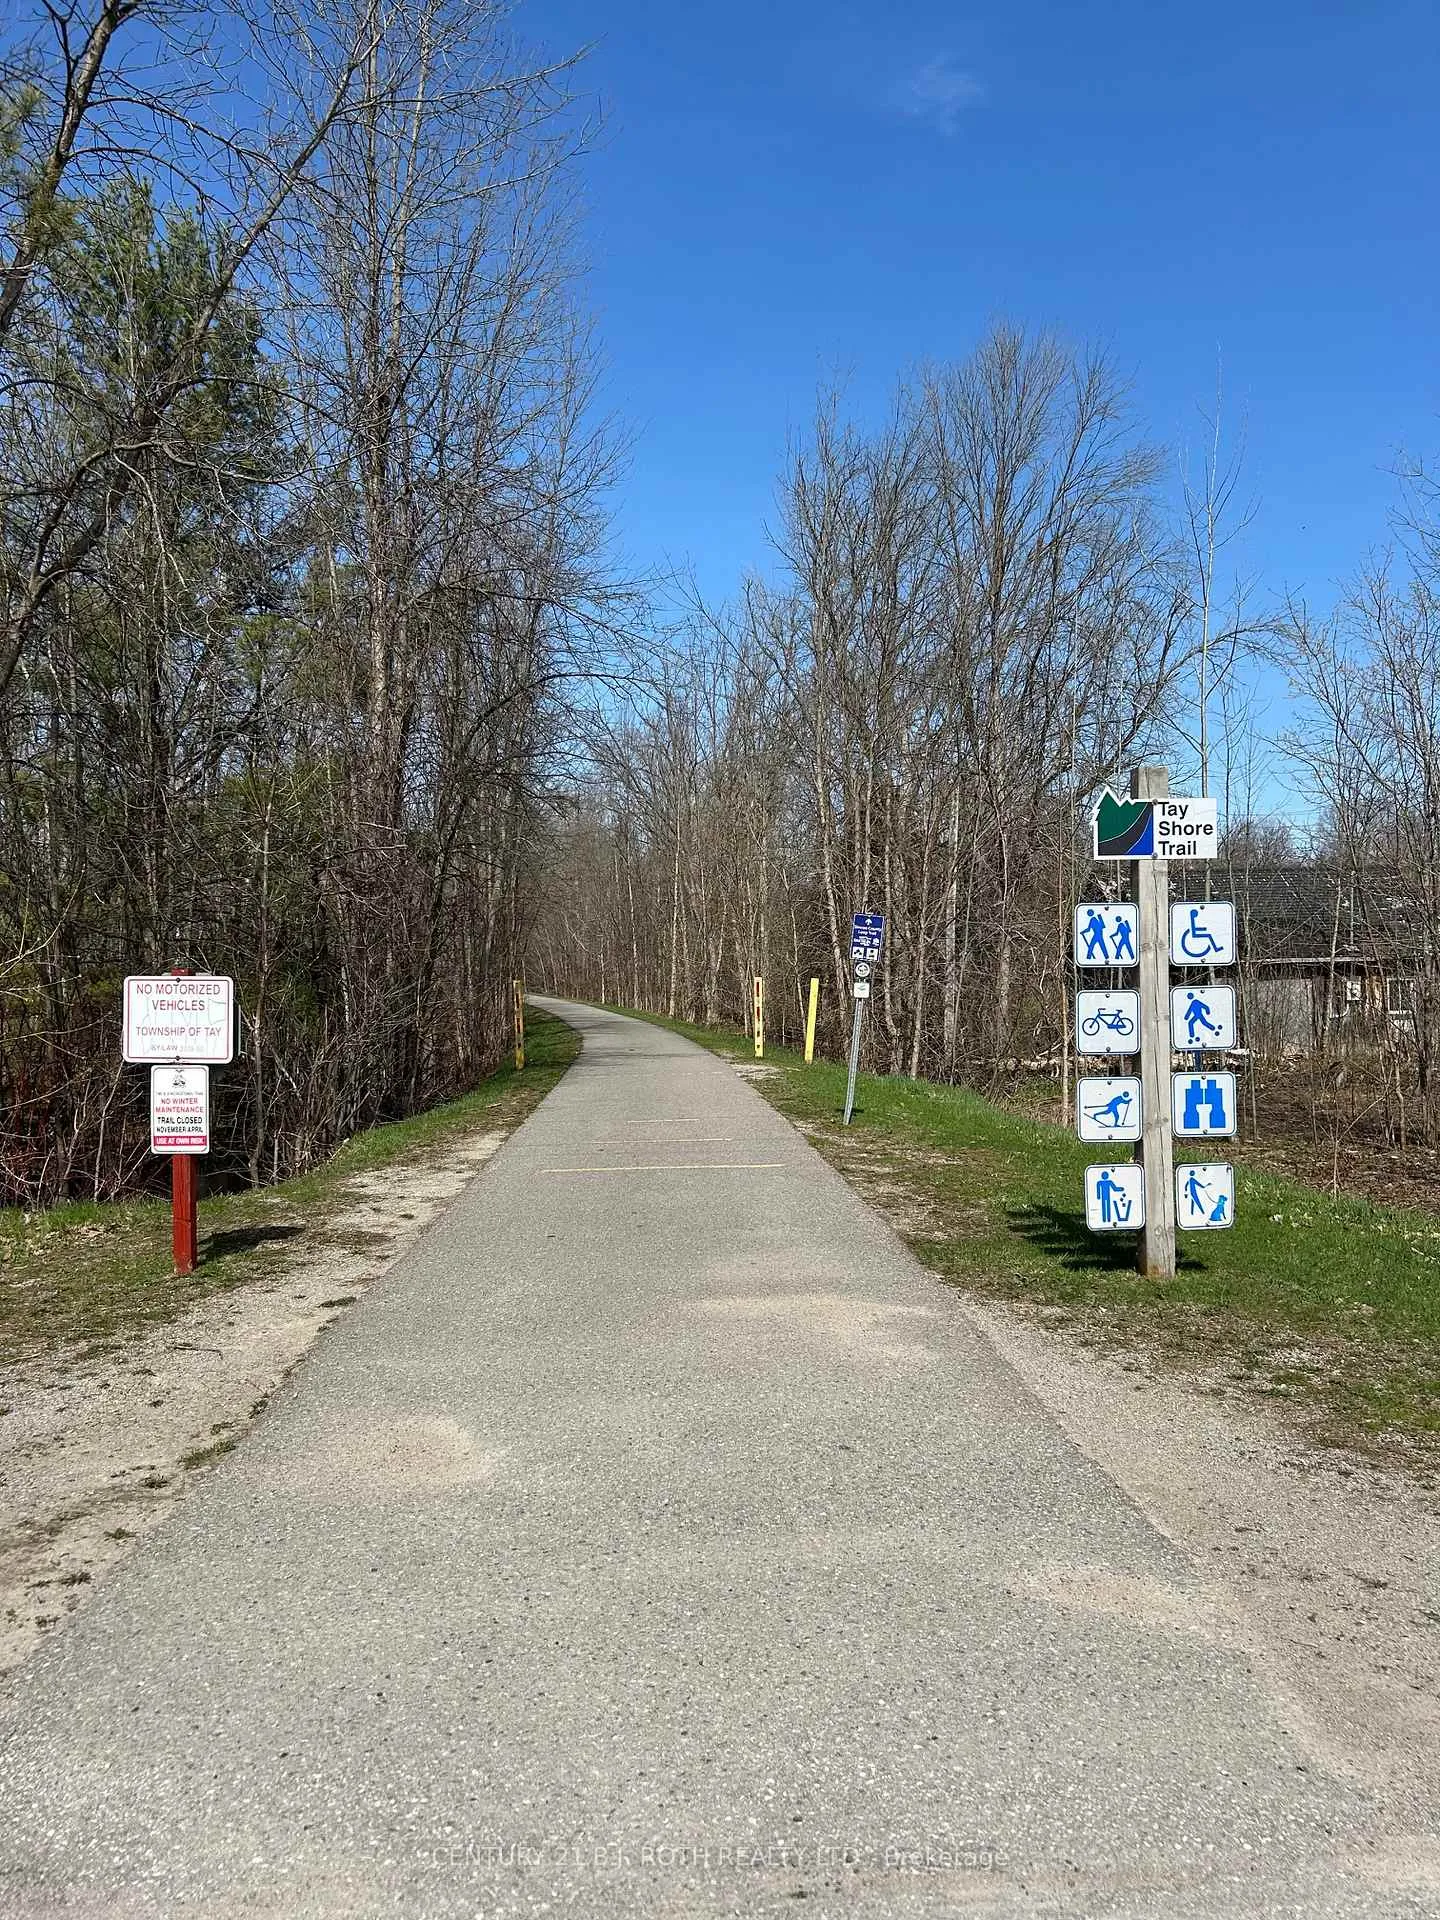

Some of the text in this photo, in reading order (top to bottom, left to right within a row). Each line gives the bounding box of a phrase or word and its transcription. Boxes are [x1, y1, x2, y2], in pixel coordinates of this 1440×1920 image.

[1158, 801, 1189, 820] Tay
[1158, 820, 1214, 836] Shore
[1158, 840, 1197, 856] Trail
[136, 983, 221, 995] NO MOTORIZED
[152, 1000, 205, 1011] VEHICLES
[136, 1026, 222, 1037] TOWNSHIP OF TAY
[161, 1097, 198, 1105] NO WINTER
[157, 1116, 203, 1124] TRAIL CLOSED
[156, 1126, 186, 1134] NOVEMBER
